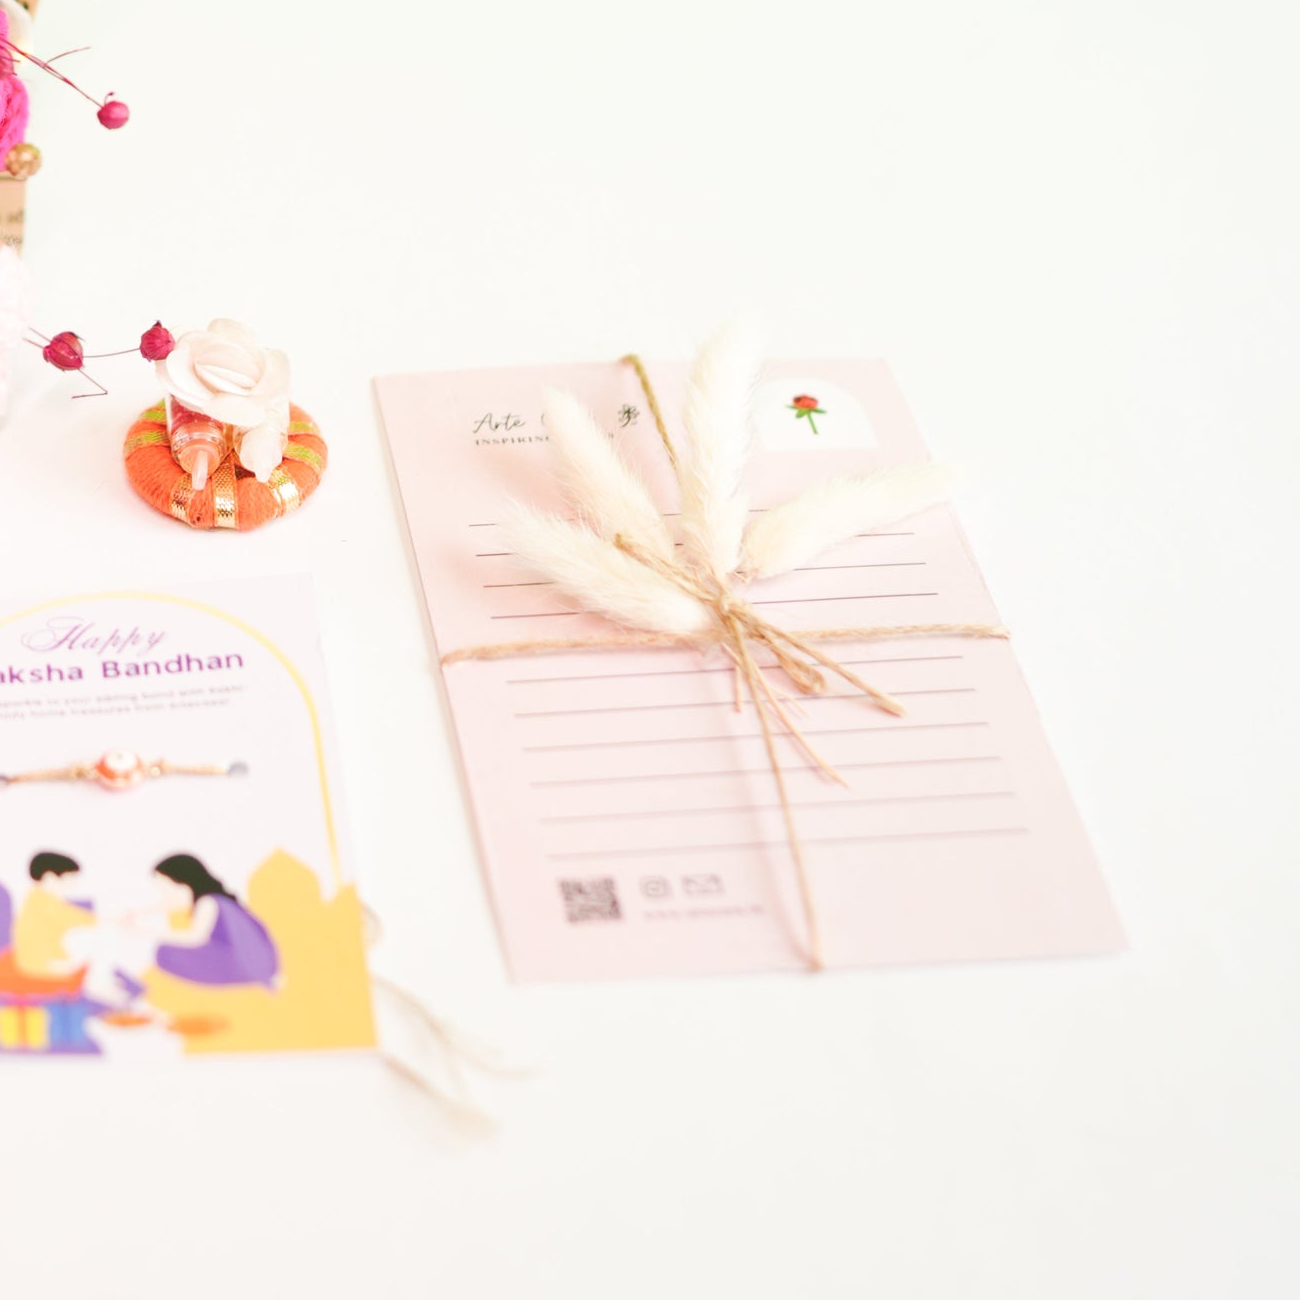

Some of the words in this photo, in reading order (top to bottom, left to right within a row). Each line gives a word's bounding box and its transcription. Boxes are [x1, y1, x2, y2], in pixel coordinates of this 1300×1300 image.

[473, 411, 525, 434] Arte
[21, 616, 166, 658] Happy
[102, 653, 245, 679] Bandhan
